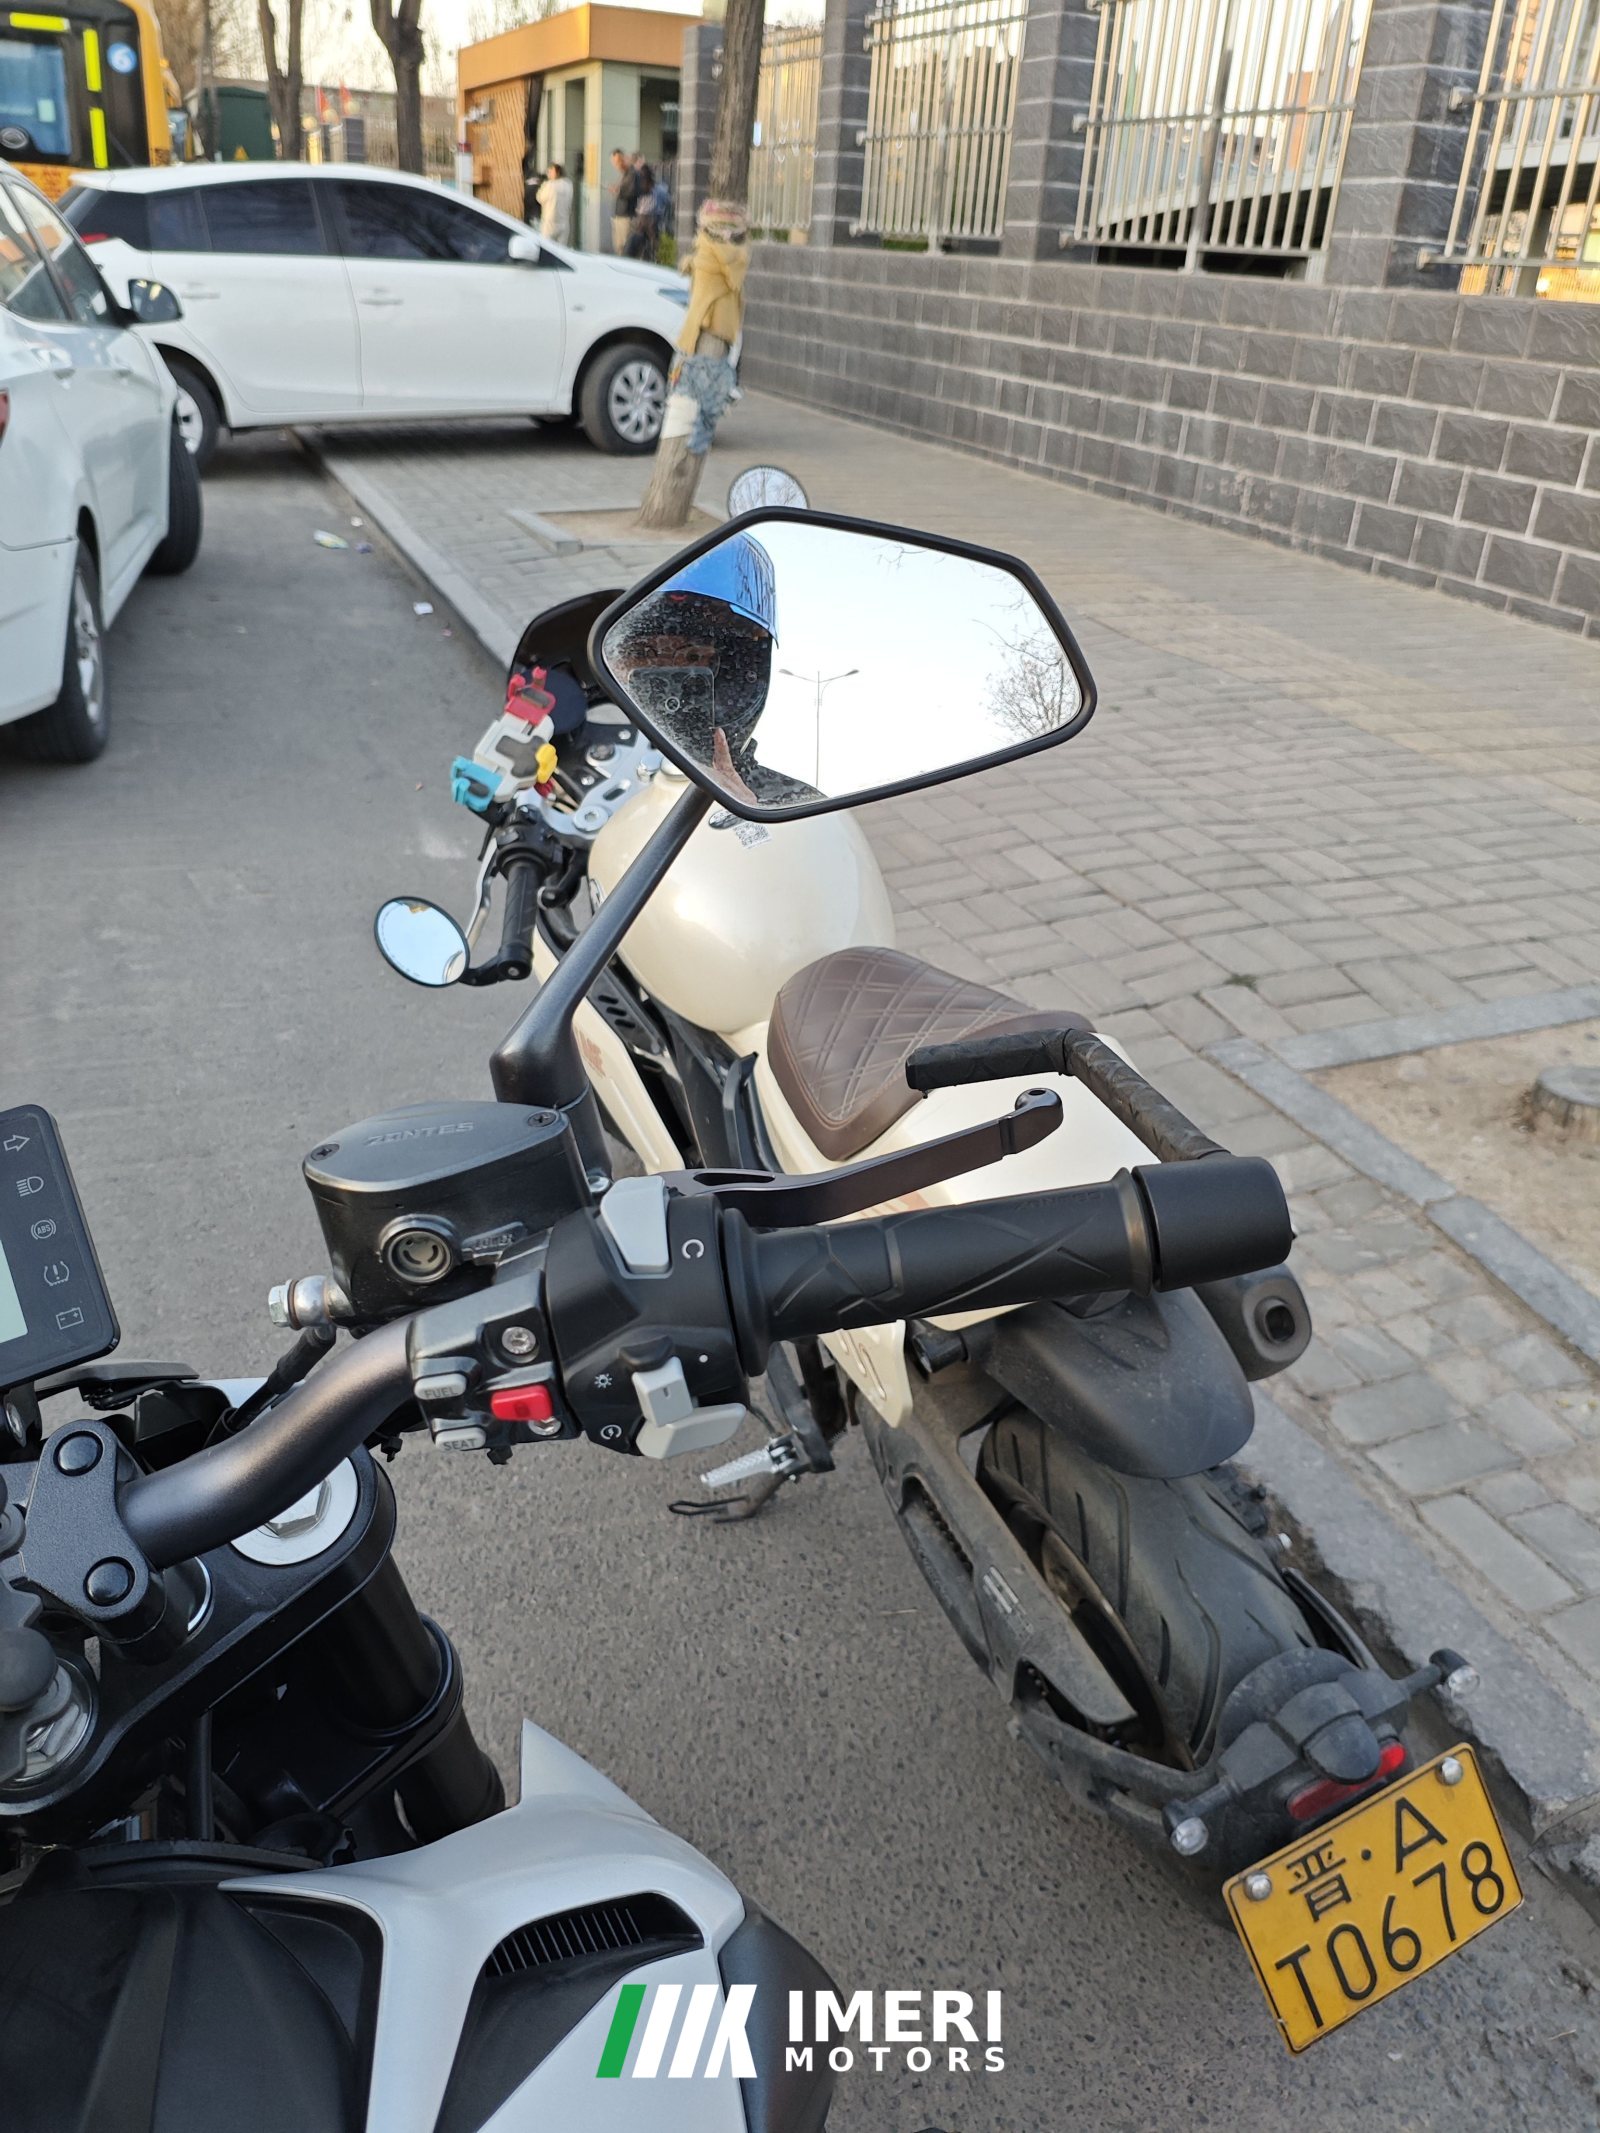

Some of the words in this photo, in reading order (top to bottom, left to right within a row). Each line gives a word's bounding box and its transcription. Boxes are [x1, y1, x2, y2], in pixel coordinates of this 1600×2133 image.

[363, 1122, 474, 1146] ZONTES
[37, 1224, 51, 1235] ABS
[423, 1386, 459, 1399] FUEL
[443, 1438, 477, 1450] SEAT
[1275, 1841, 1504, 2028] T0678
